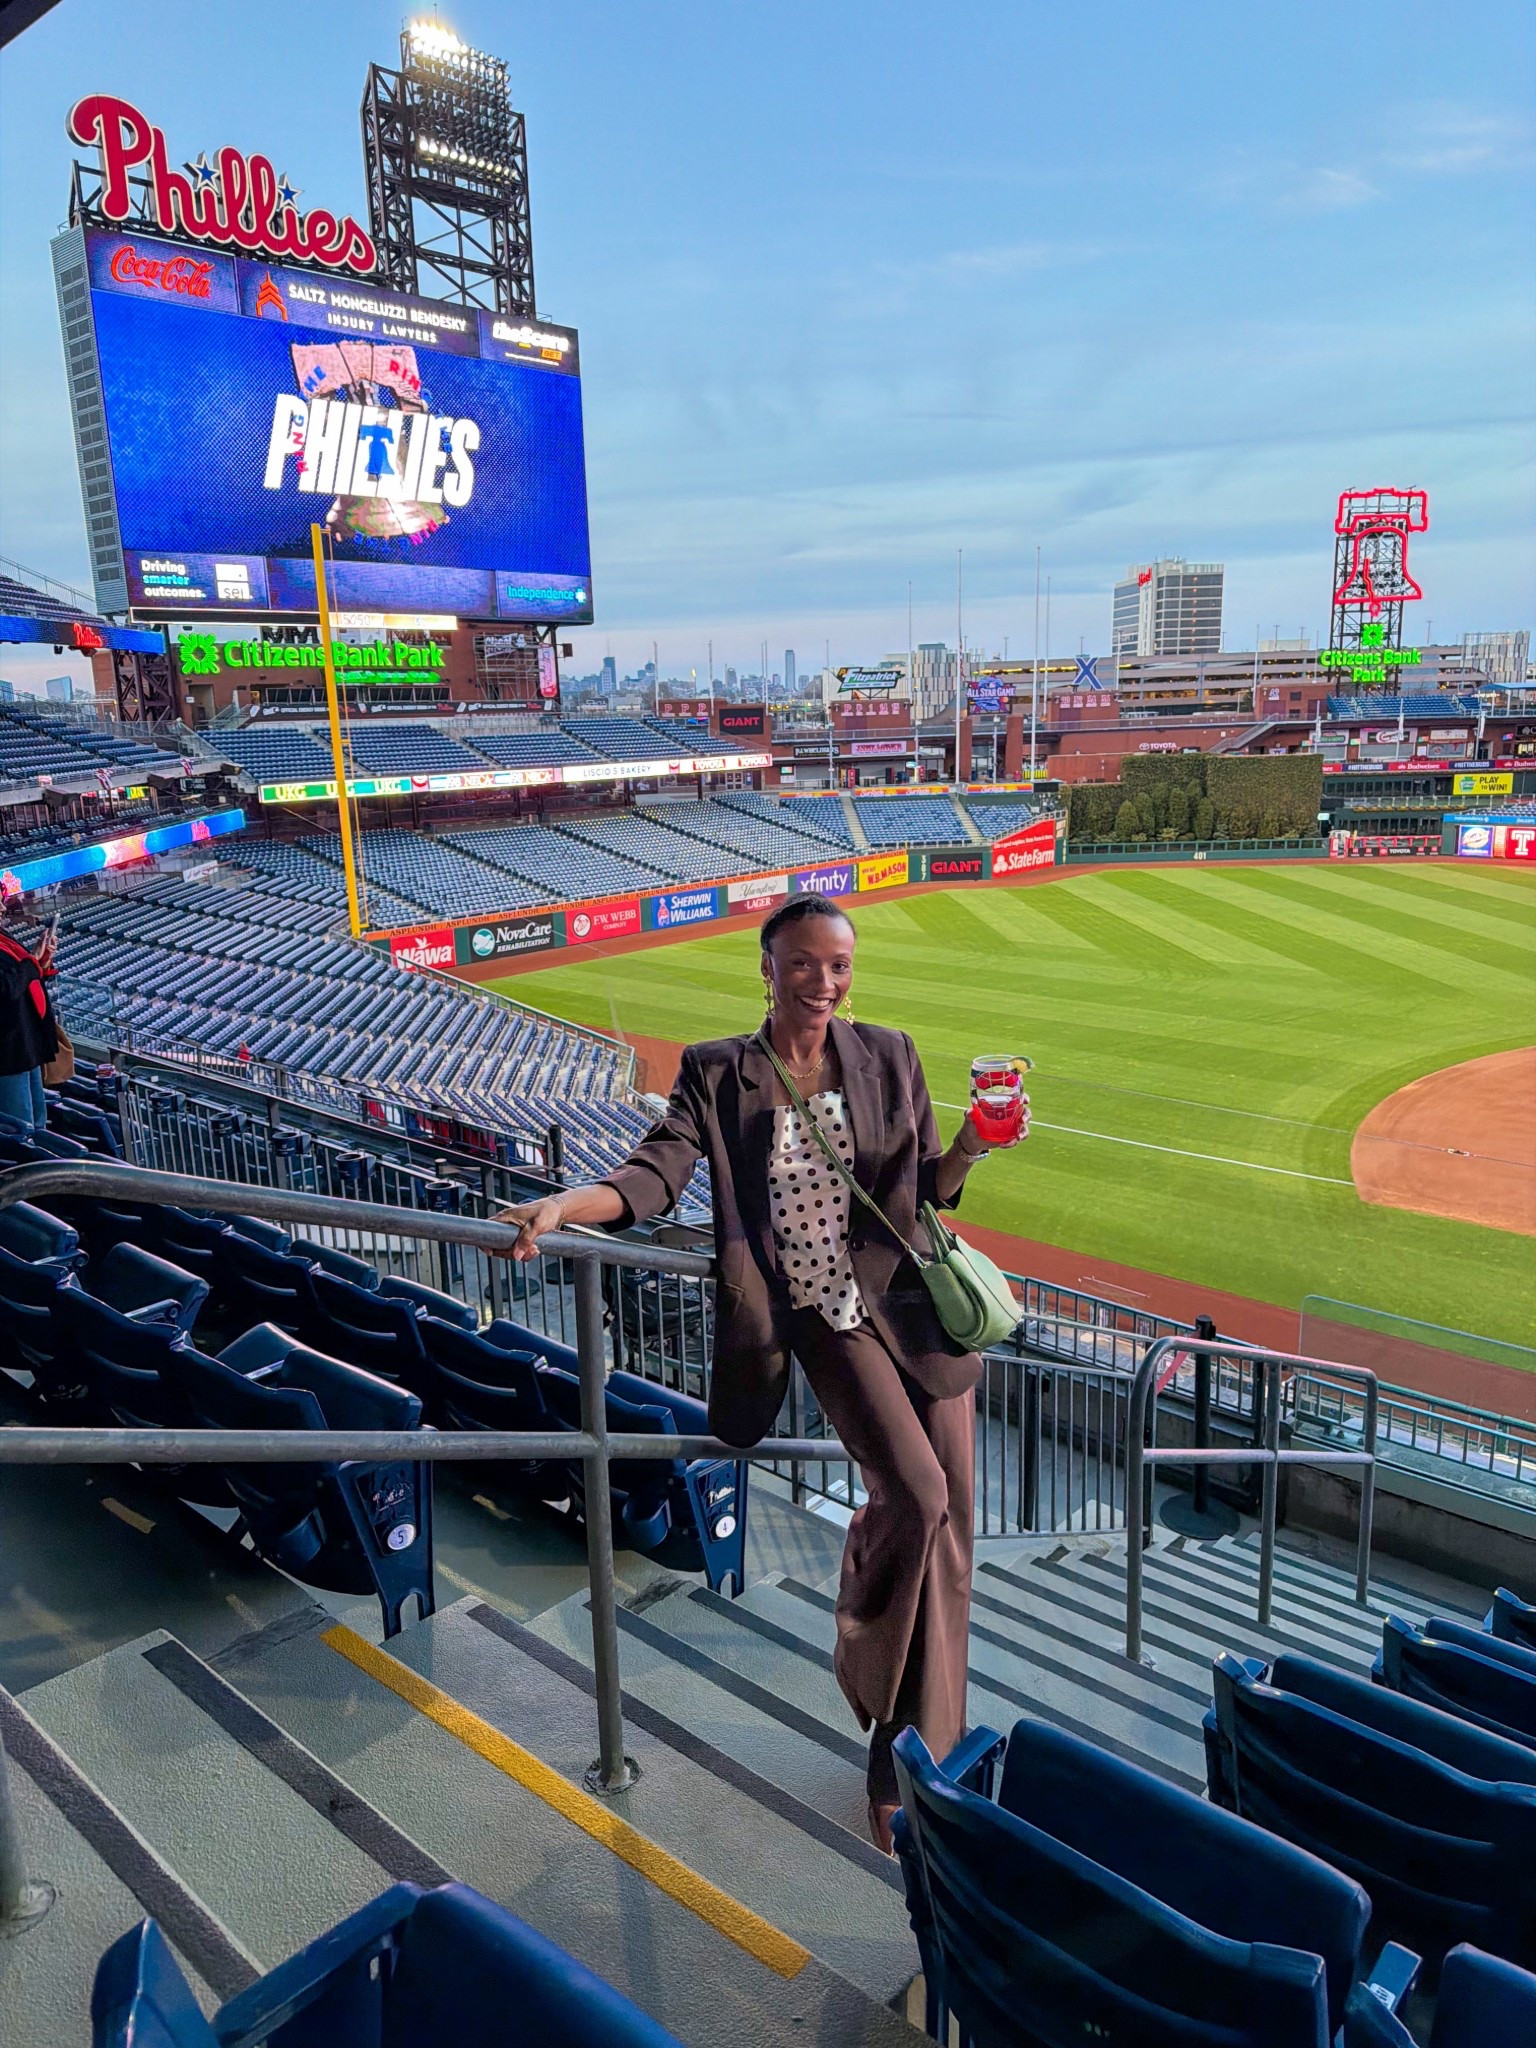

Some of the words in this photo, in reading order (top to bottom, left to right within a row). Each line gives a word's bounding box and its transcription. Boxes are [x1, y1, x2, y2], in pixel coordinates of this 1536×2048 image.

[66, 92, 377, 273] Phillies
[110, 245, 215, 298] Coca-Cola
[288, 284, 327, 304] SALTZ
[330, 293, 407, 321] MONGELUZZI
[410, 308, 467, 332] BENDESKY
[327, 312, 374, 332] INJURY
[382, 323, 438, 343] LAWYERS
[542, 349, 562, 360] BET
[141, 559, 186, 576] Driving
[142, 575, 190, 586] smarter
[144, 586, 207, 598] outcomes.
[507, 585, 574, 600] Independence
[223, 640, 326, 668] Citizens
[332, 639, 393, 667] Bank
[393, 640, 446, 667] Park
[1320, 649, 1381, 667] Citizens
[1383, 647, 1423, 665] Bank
[842, 667, 898, 683] Fitzpatrick
[1071, 656, 1105, 691] X
[1353, 667, 1386, 682] Park
[966, 688, 980, 698] ALL
[980, 687, 996, 697] STAR
[996, 686, 1016, 697] GAME
[664, 703, 673, 712] P
[681, 703, 690, 712] P
[698, 702, 707, 712] P
[723, 717, 760, 727] GIANT
[1149, 742, 1177, 750] TOYOTA
[694, 759, 724, 770] TOYOTA
[739, 755, 768, 767] TOYOTA
[1407, 762, 1440, 770] Budweiser
[621, 765, 651, 775] BAKERY
[1479, 776, 1500, 784] PLAY
[1488, 783, 1508, 792] WIN!
[325, 782, 355, 797] UG
[1511, 829, 1536, 852] T
[930, 860, 982, 873] GIANT
[741, 880, 778, 897] Yuengling
[800, 870, 848, 893] xfinity
[390, 923, 437, 937] ASPLUNDH
[445, 915, 490, 928] ASPLUNDH
[497, 908, 540, 919] ASPLUNDH
[547, 901, 585, 912] ASPLUNDH
[592, 894, 629, 905] ASPLUNDH
[635, 887, 670, 898] ASPLUNDH
[676, 882, 709, 893] ASPLUNDH
[714, 875, 745, 886] ASPLUNDH
[750, 870, 780, 880] ASPLUNDH
[670, 893, 712, 909] SHERWIN
[747, 897, 772, 910] LAGER
[610, 909, 637, 922] WEBB
[670, 907, 712, 923] WILLIAMS
[496, 922, 552, 943] NovaCare
[603, 921, 627, 930] COMPANY
[497, 937, 551, 952] REHABILITATION
[395, 945, 453, 970] Wawa
[722, 1521, 728, 1533] 4
[397, 1530, 405, 1545] 5
